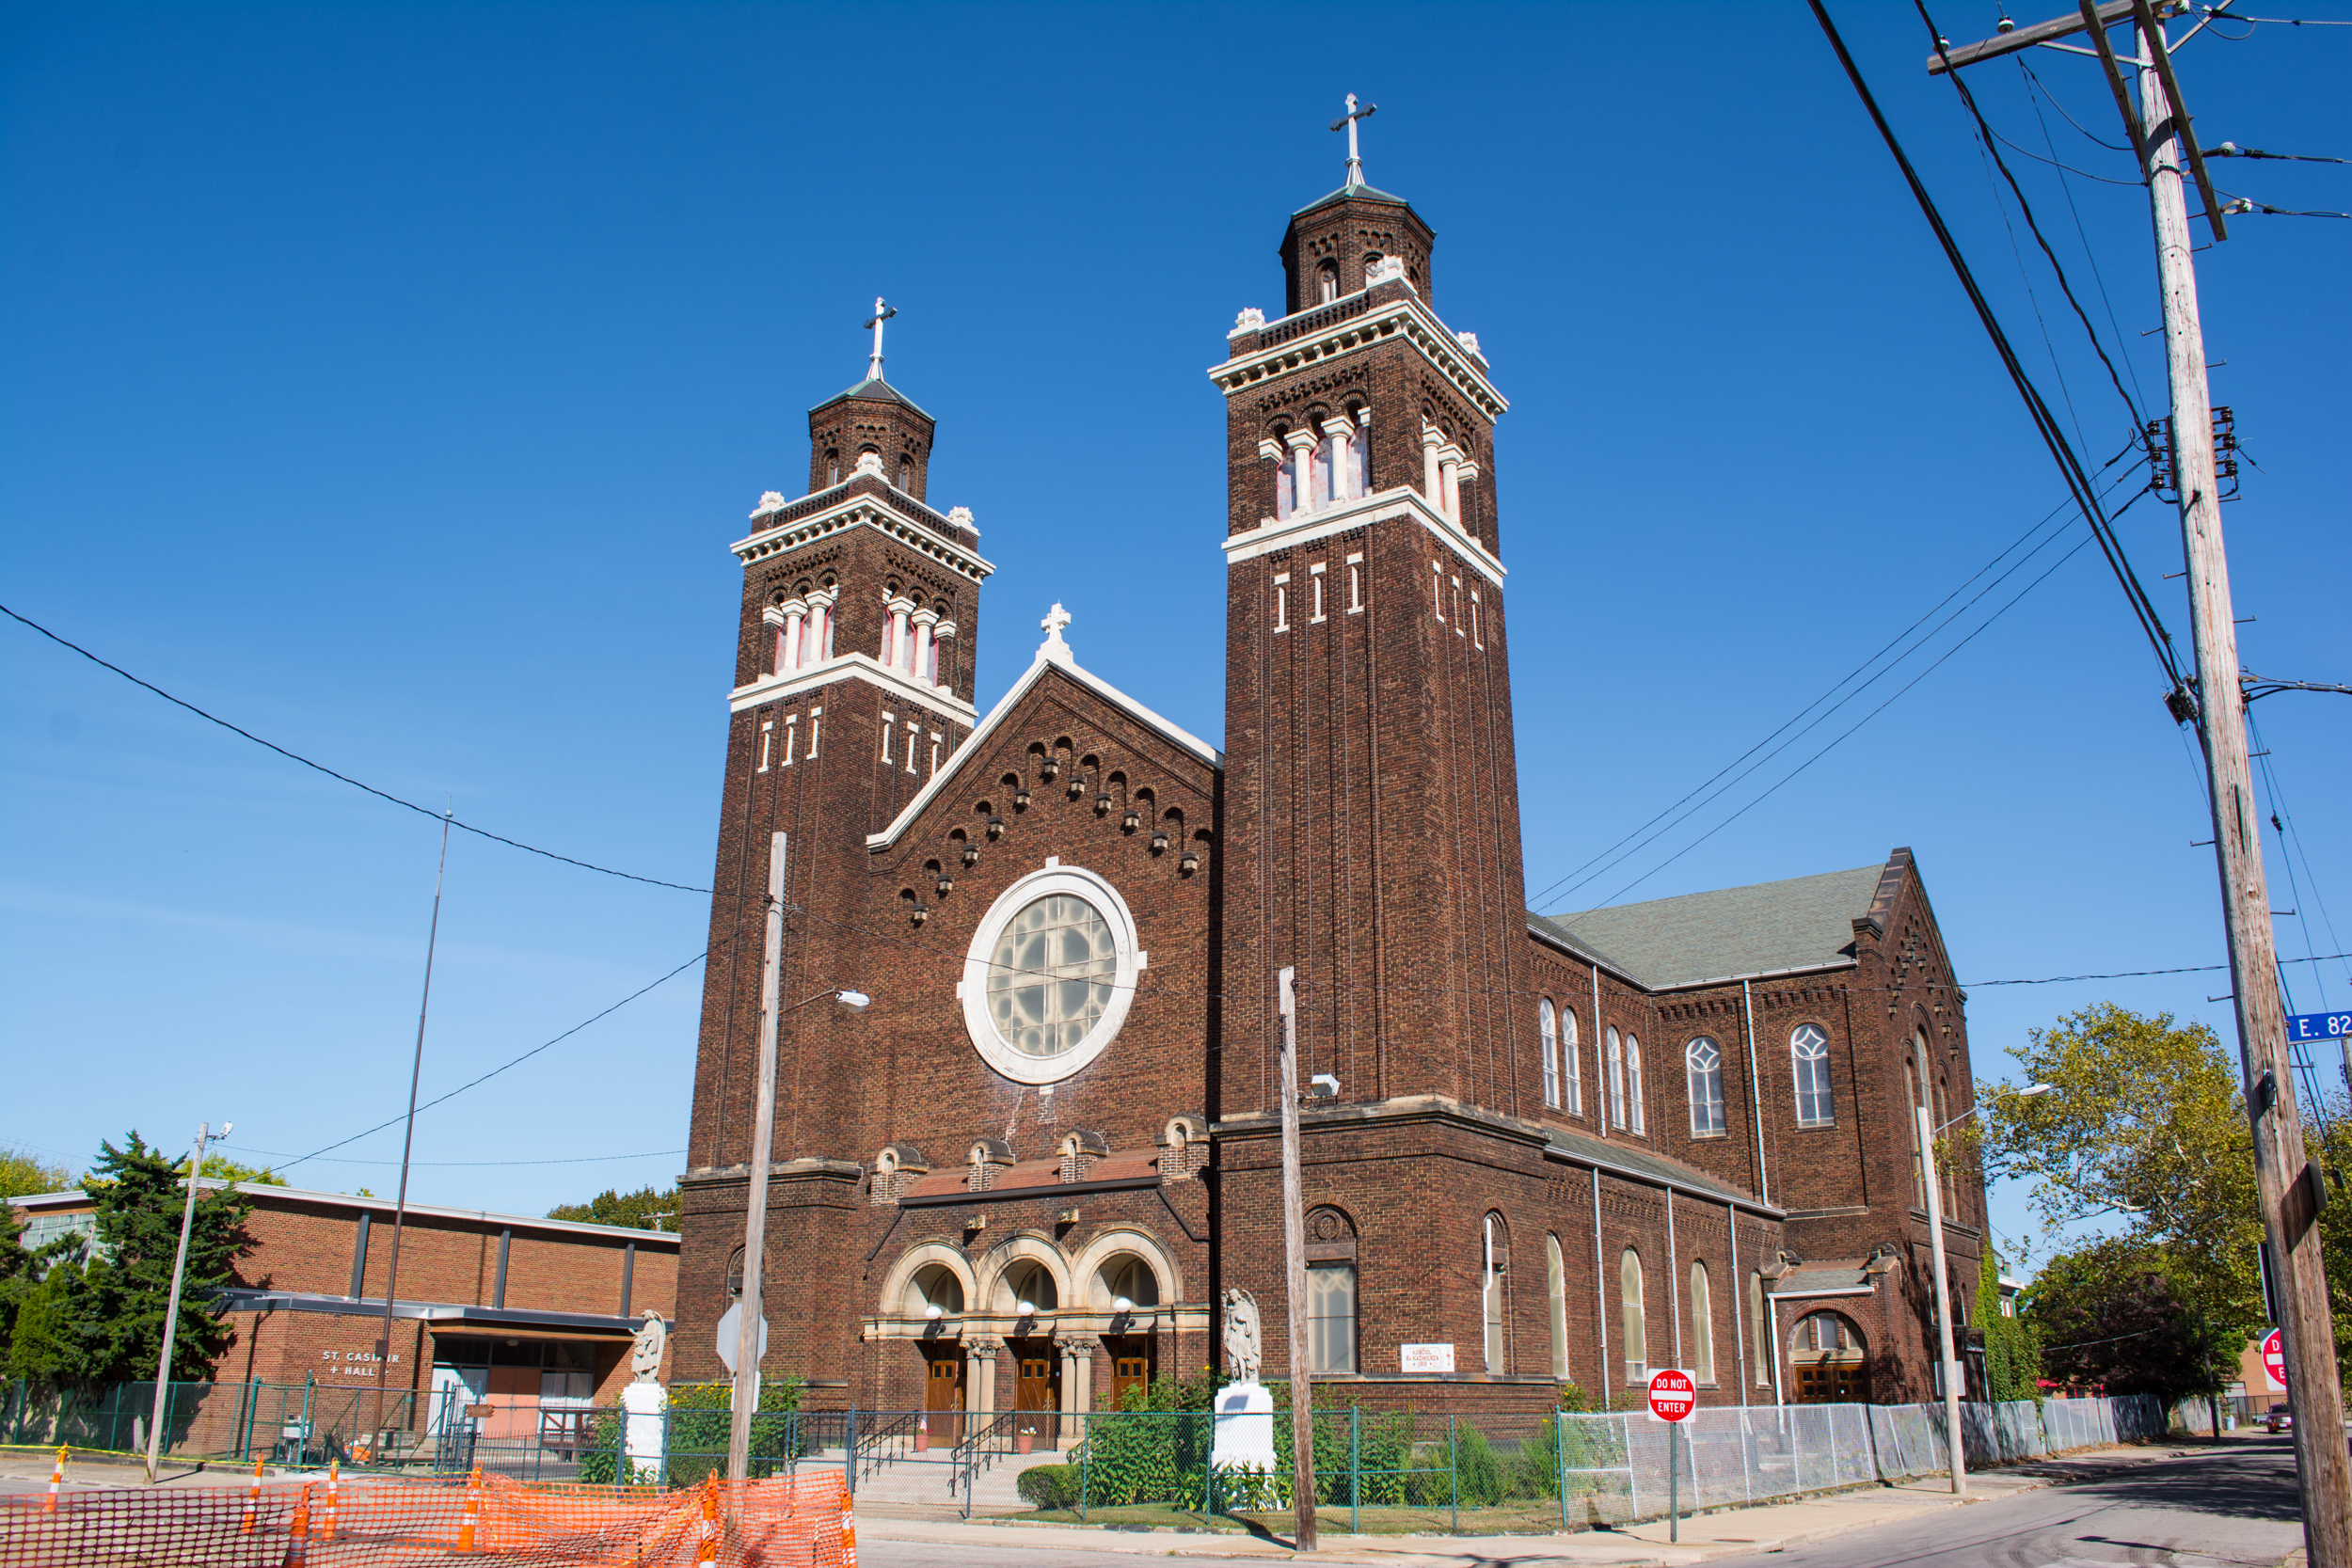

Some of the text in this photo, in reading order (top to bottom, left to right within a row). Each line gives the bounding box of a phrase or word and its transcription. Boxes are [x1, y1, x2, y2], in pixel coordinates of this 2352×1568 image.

[2298, 1019, 2319, 1037] E.
[323, 1351, 399, 1362] ST. CASIIR
[344, 1366, 375, 1376] HALL
[1656, 1378, 1687, 1389] DO NOT
[1658, 1402, 1685, 1413] ENTER
